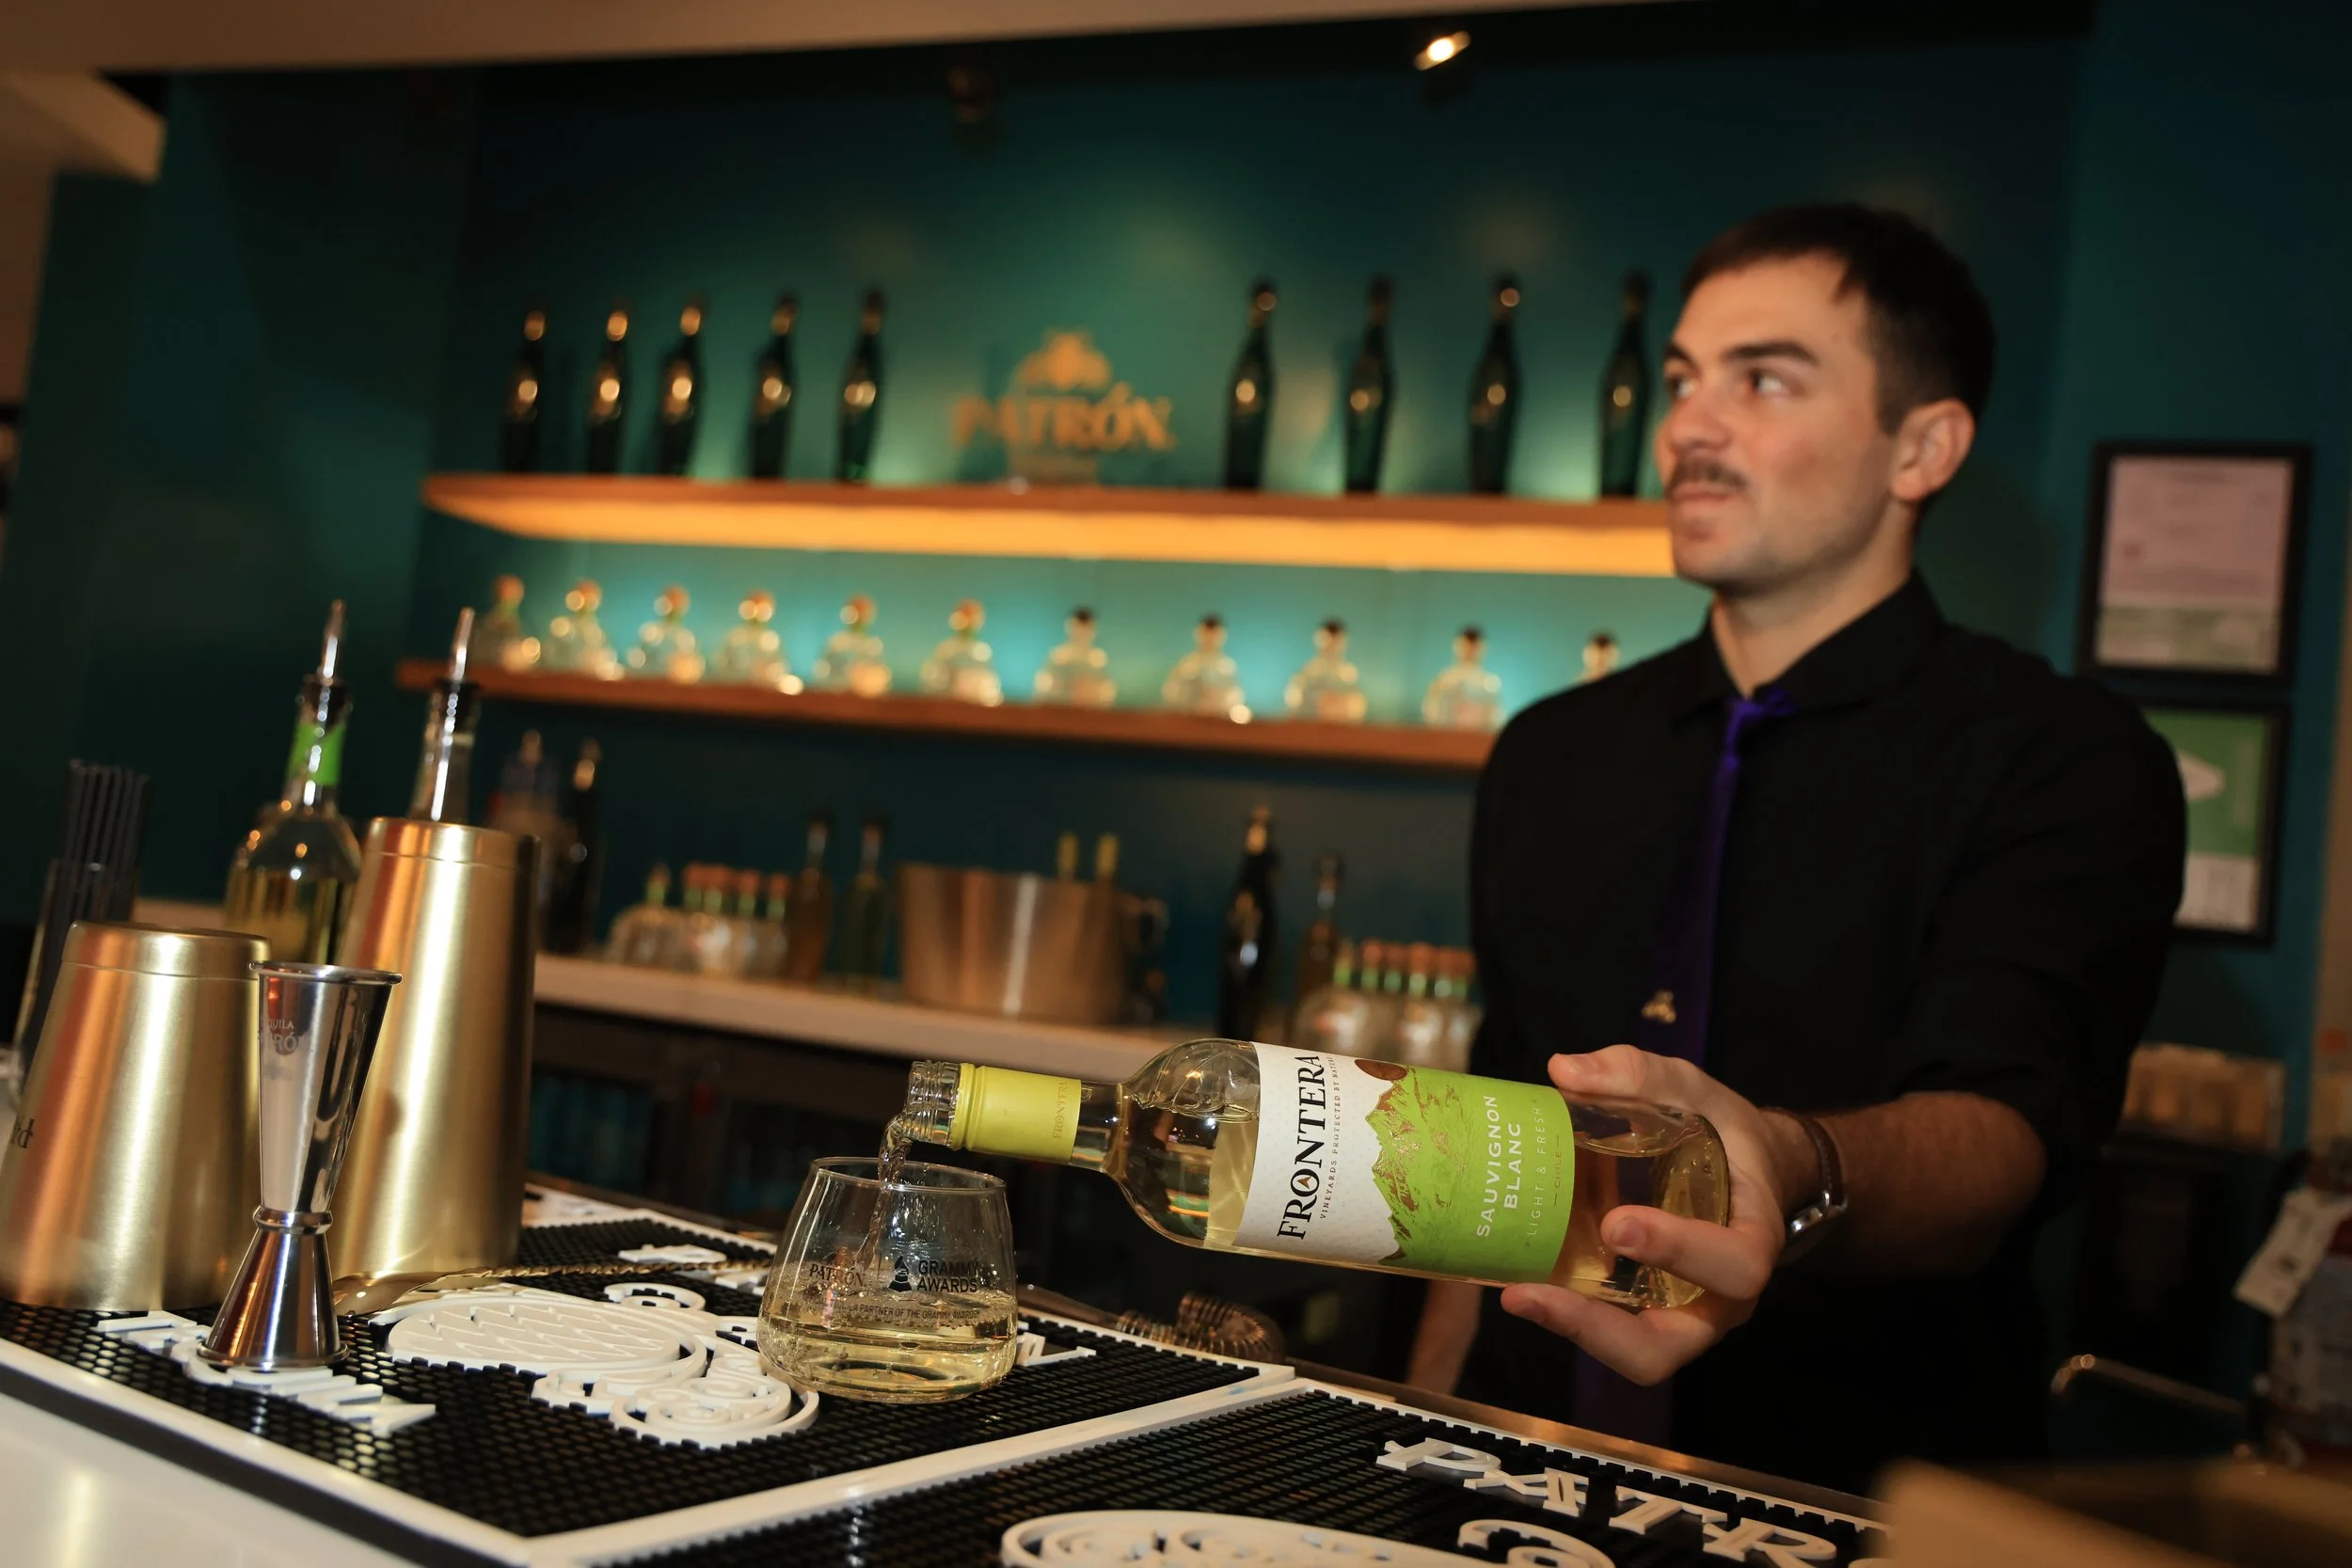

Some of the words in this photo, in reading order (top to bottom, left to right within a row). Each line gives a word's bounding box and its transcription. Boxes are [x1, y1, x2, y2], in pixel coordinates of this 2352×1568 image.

[1332, 1081, 1341, 1092] BY
[1277, 1056, 1327, 1240] FRONTERA
[1330, 1095, 1342, 1155] PROTECTED
[1533, 1107, 1547, 1155] FRESH
[1319, 1160, 1338, 1219] VINEYARDS
[1476, 1096, 1502, 1238] SAUVIGNON
[1503, 1123, 1522, 1210] BLANC
[1536, 1165, 1547, 1174] &
[1554, 1151, 1563, 1188] CHILE
[1528, 1185, 1545, 1236] LIGHT
[916, 1276, 978, 1293] AWARDS
[918, 1259, 979, 1275] GRAMMY
[859, 1304, 894, 1317] PARTNER
[895, 1308, 905, 1318] OF
[906, 1308, 921, 1319] THE
